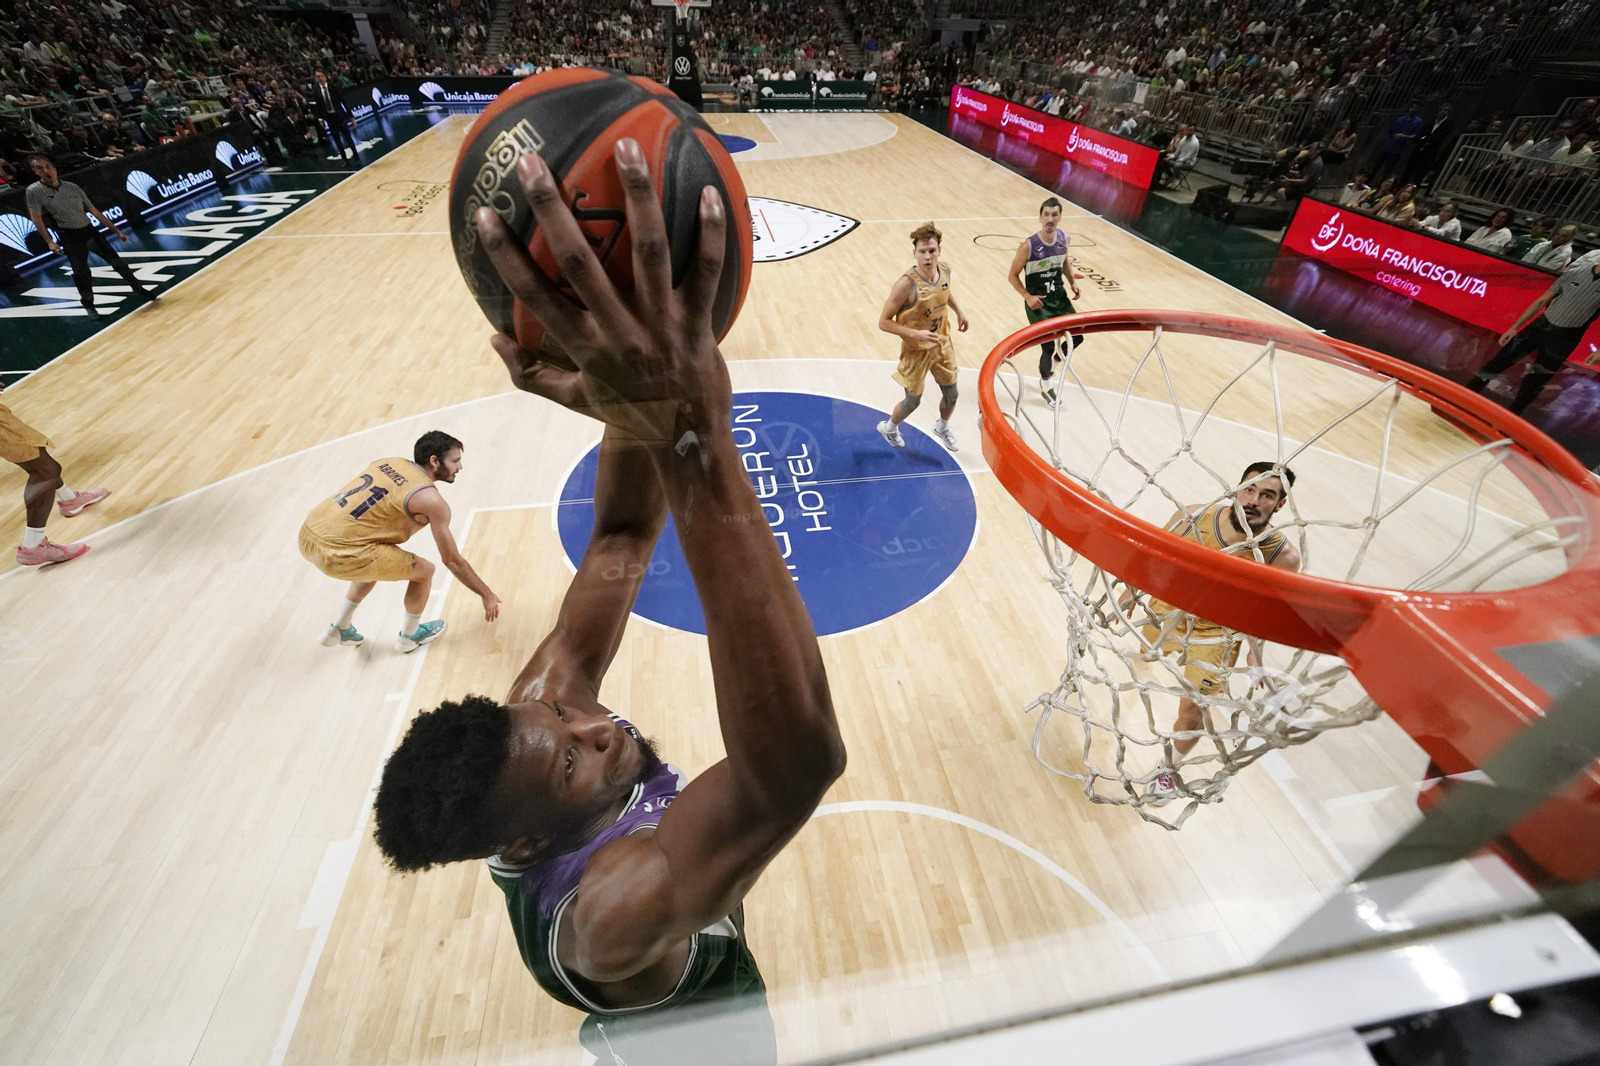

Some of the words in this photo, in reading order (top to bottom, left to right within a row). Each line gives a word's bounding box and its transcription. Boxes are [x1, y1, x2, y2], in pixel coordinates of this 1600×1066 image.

[444, 91, 475, 102] Unicaja
[474, 92, 499, 101] Banco
[1078, 138, 1093, 151] DOÑA
[1092, 143, 1128, 165] FRANCISQUITA
[157, 174, 191, 198] Unicaja
[186, 169, 213, 187] Banco
[86, 206, 123, 227] Bnco
[0, 189, 317, 318] MÁLAGA
[1342, 233, 1379, 259] DOÑA
[1381, 247, 1488, 298] FRANCISQUITA
[1044, 280, 1056, 294] 14
[1376, 271, 1422, 297] catering
[377, 463, 408, 487] ABRINES
[787, 443, 832, 532] HOTEL
[333, 473, 389, 520] 21
